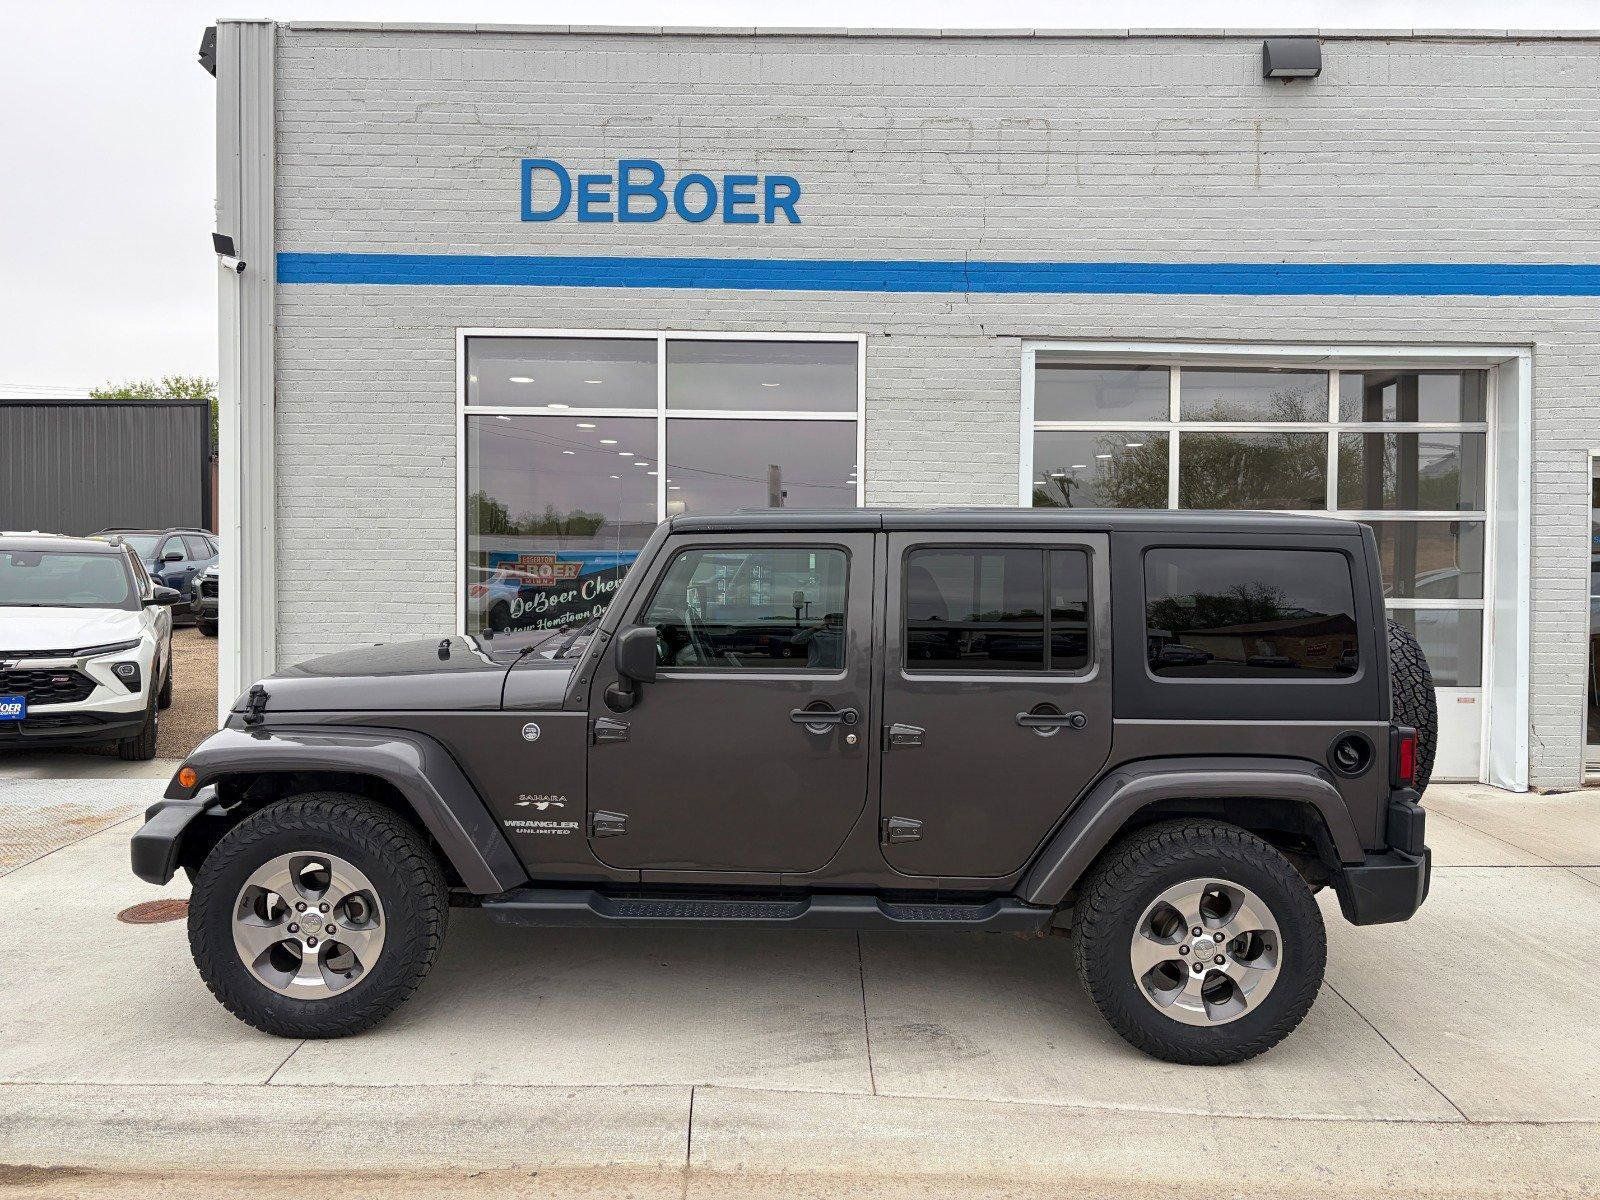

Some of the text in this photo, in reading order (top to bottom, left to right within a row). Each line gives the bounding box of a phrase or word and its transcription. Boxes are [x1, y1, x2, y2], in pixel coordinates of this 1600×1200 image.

[510, 590, 577, 619] DeBoer
[536, 610, 590, 630] Hometown
[0, 703, 22, 712] OER
[504, 820, 579, 829] WRANGLER
